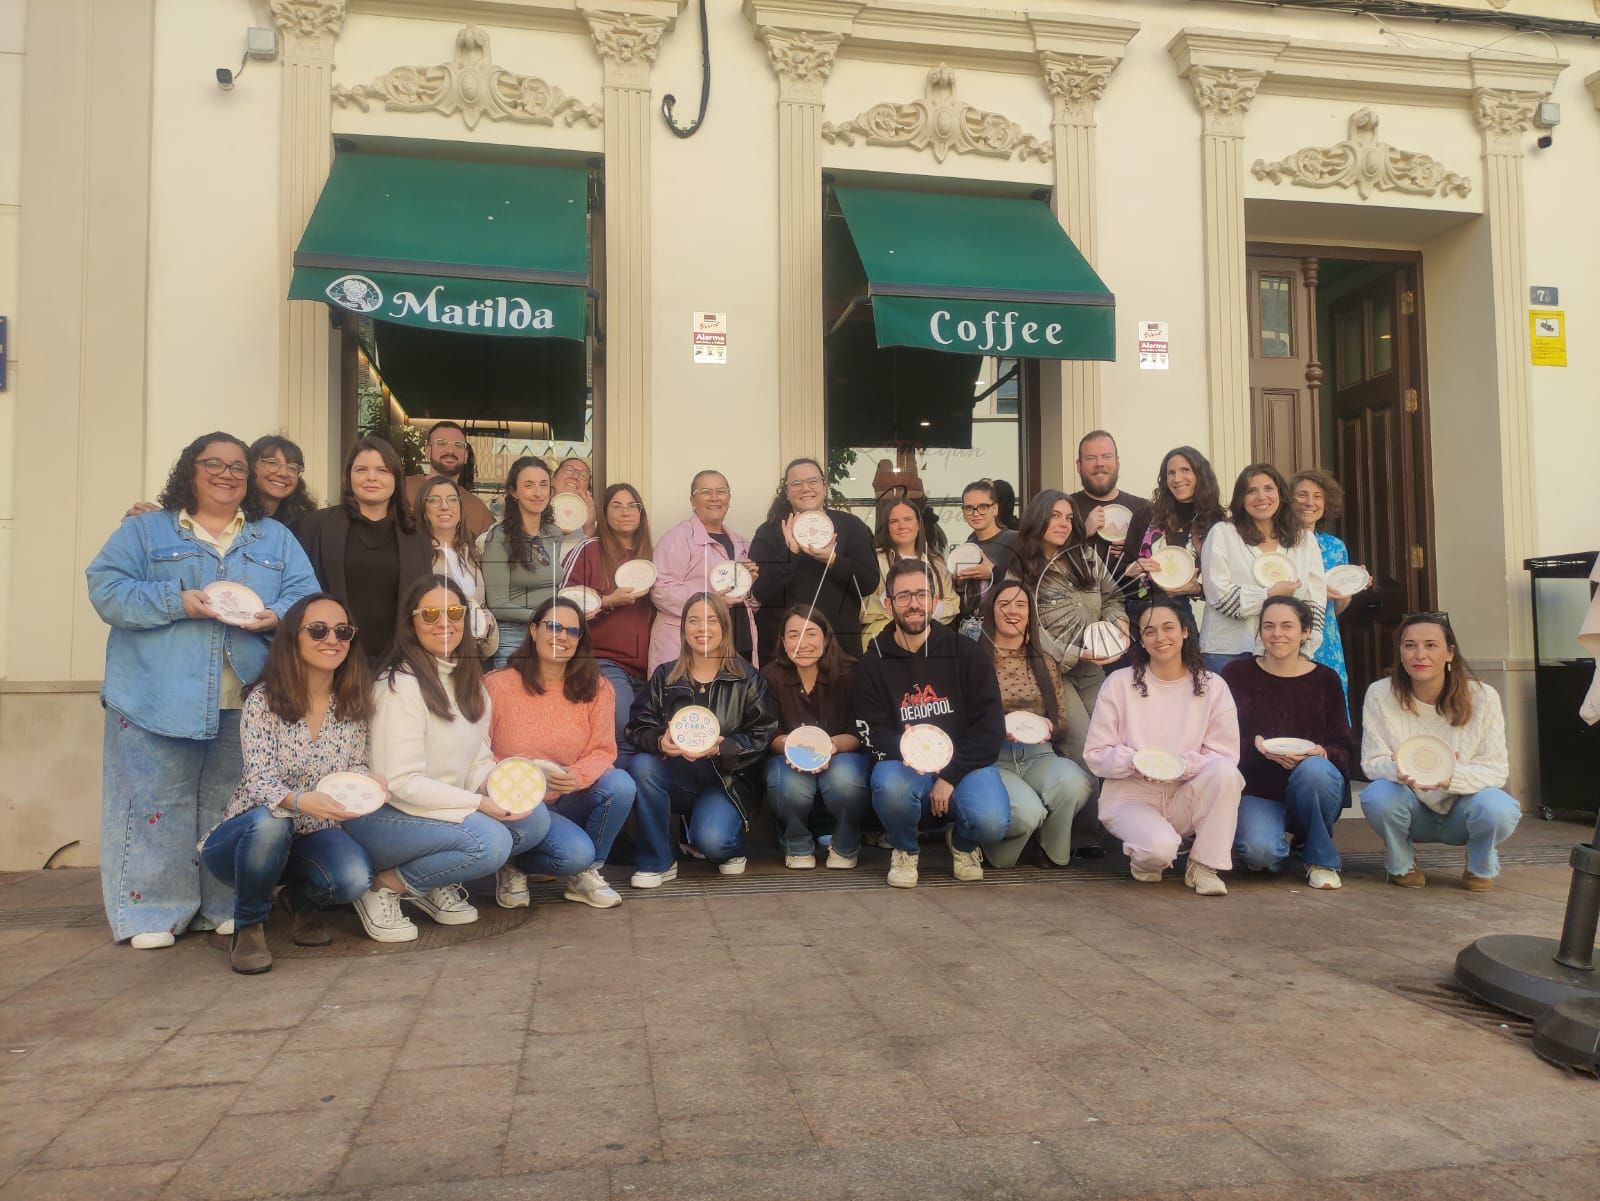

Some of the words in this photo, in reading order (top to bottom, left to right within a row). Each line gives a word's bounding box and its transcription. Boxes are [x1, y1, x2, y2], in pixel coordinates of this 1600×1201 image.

[388, 285, 555, 329] Matilda
[930, 310, 1063, 351] Coffee
[900, 699, 954, 721] DEADPOOL
